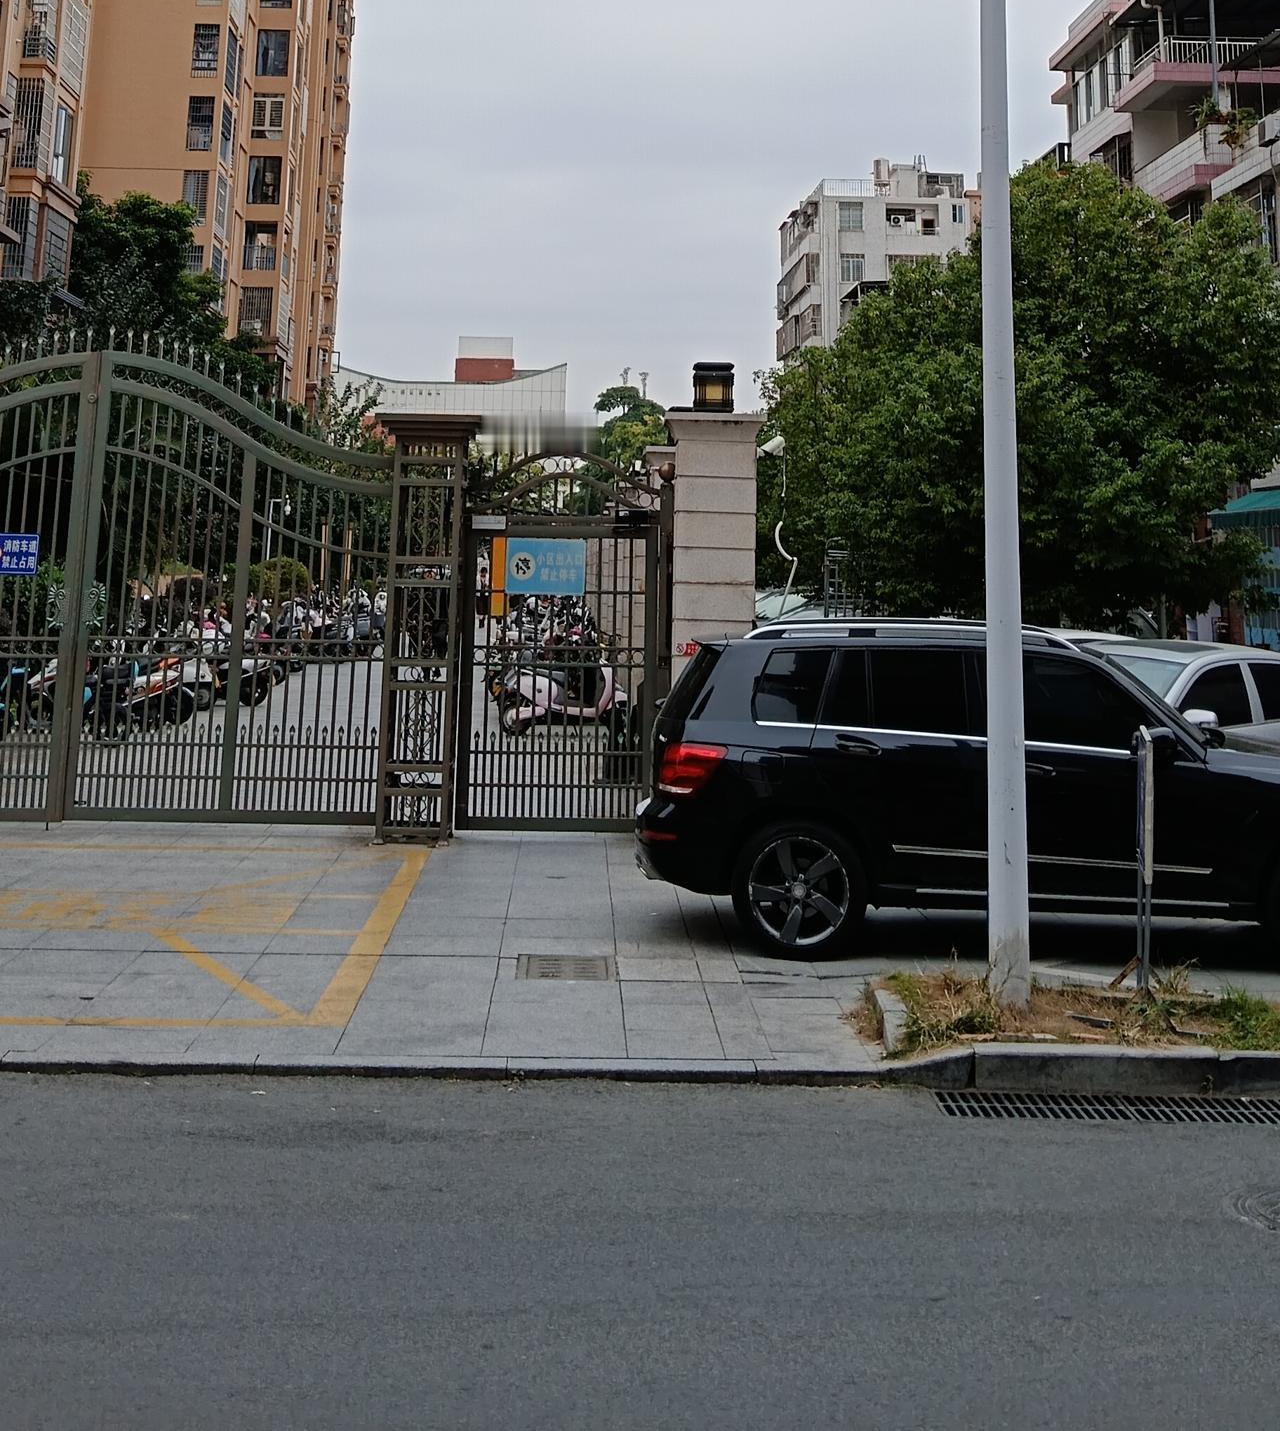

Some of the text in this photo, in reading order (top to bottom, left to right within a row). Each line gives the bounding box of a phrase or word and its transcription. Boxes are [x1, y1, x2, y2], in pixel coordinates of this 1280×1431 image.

[3, 539, 37, 552] 消防车道
[1, 555, 35, 568] 禁止占用
[536, 552, 583, 565] 小区出入口
[540, 567, 577, 581] 禁止停车
